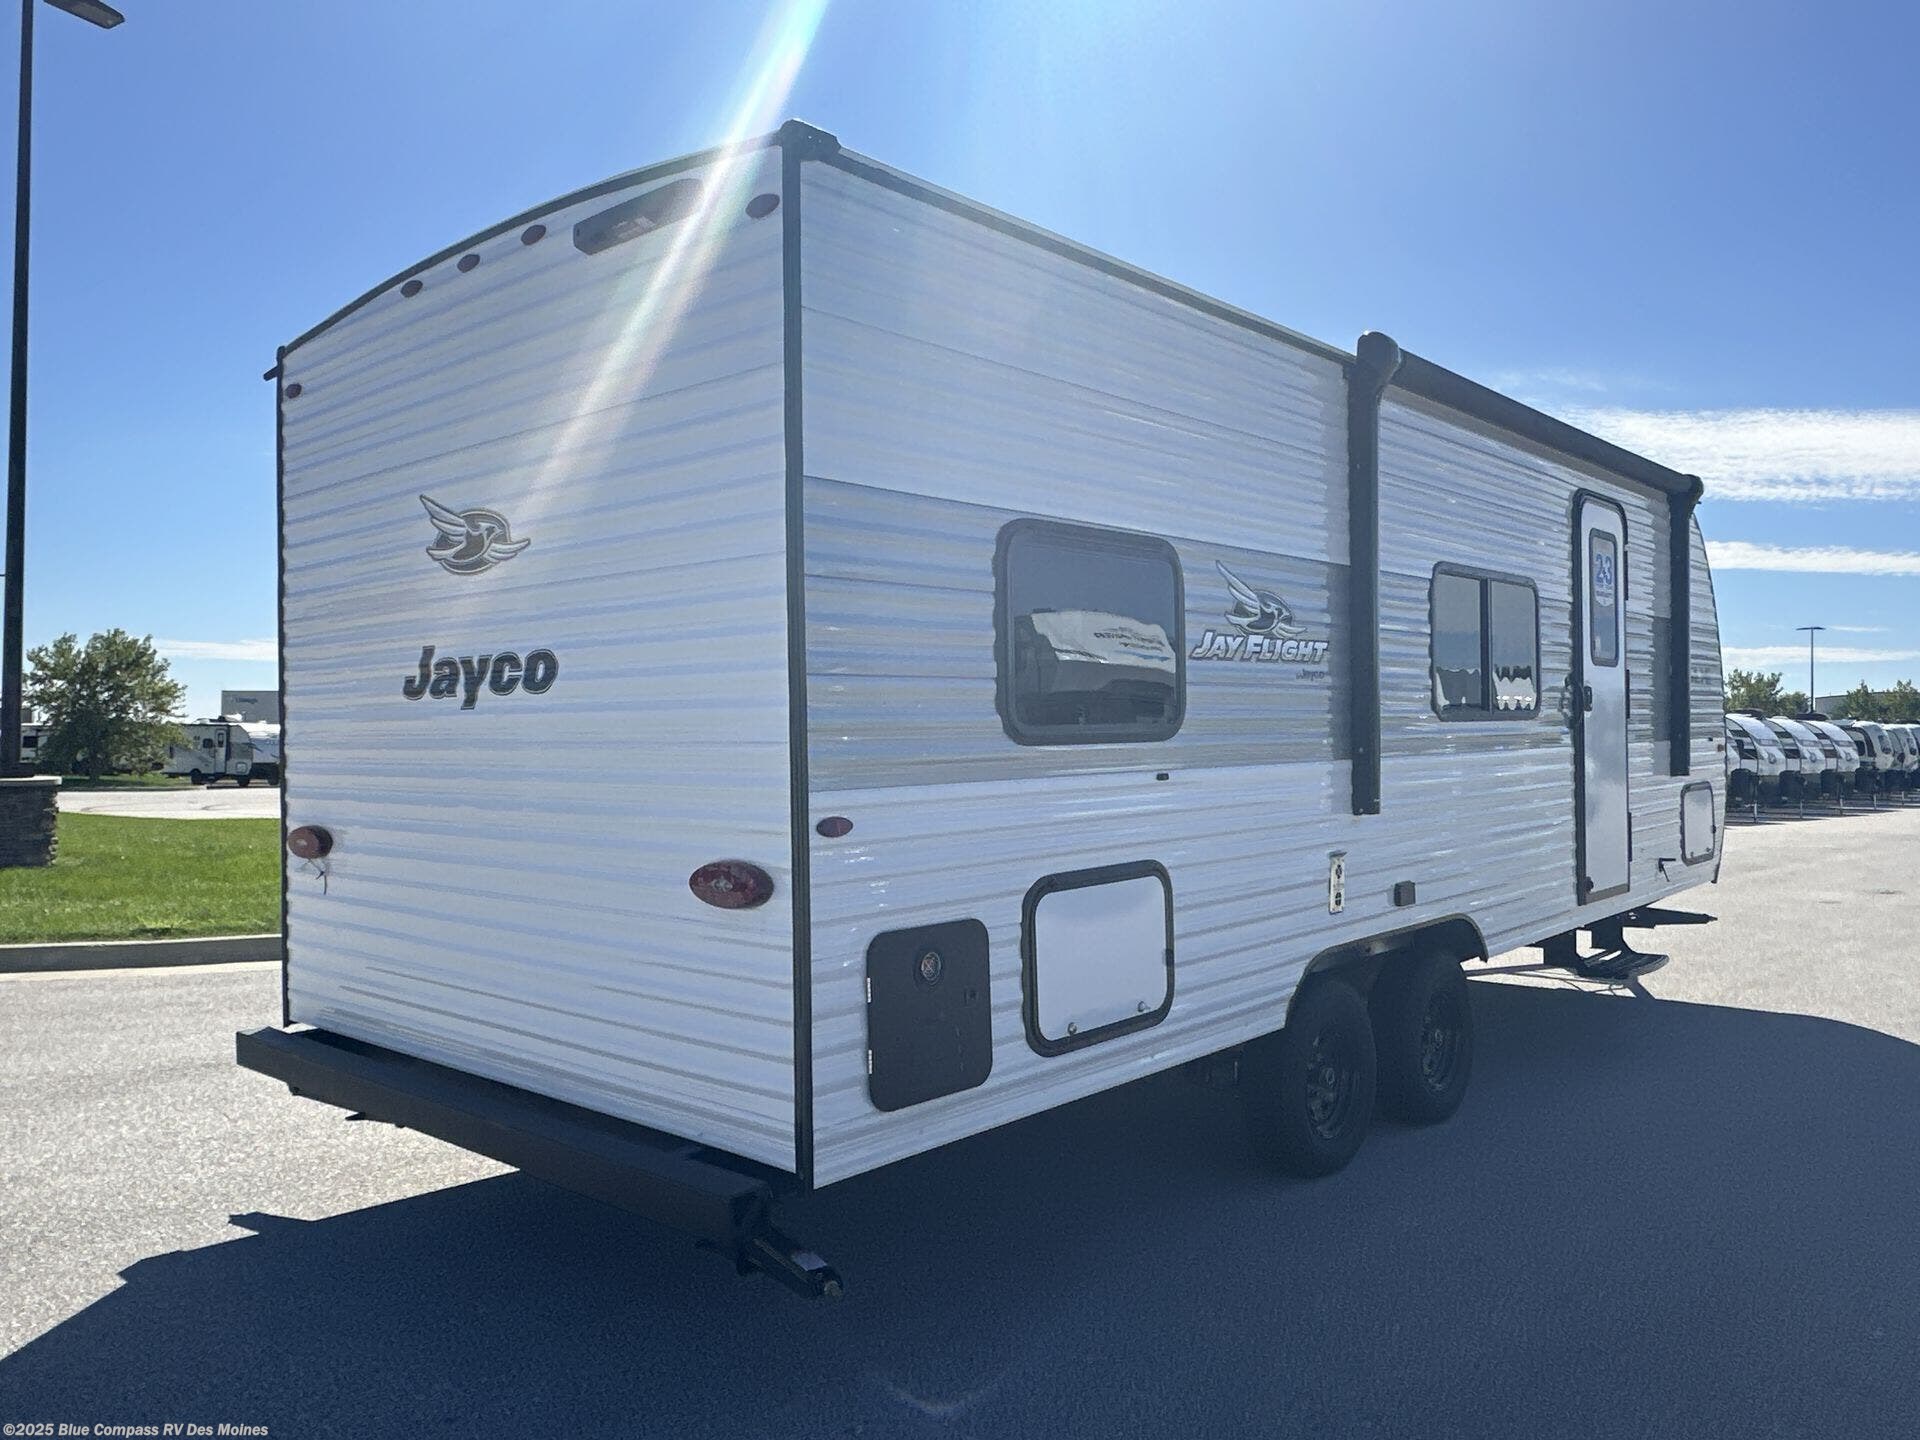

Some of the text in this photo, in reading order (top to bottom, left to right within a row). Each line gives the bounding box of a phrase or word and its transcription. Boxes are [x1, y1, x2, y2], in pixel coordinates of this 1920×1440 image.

[1190, 630, 1245, 660] JAY
[1241, 633, 1329, 664] FLIGHT
[403, 645, 559, 710] Jayco
